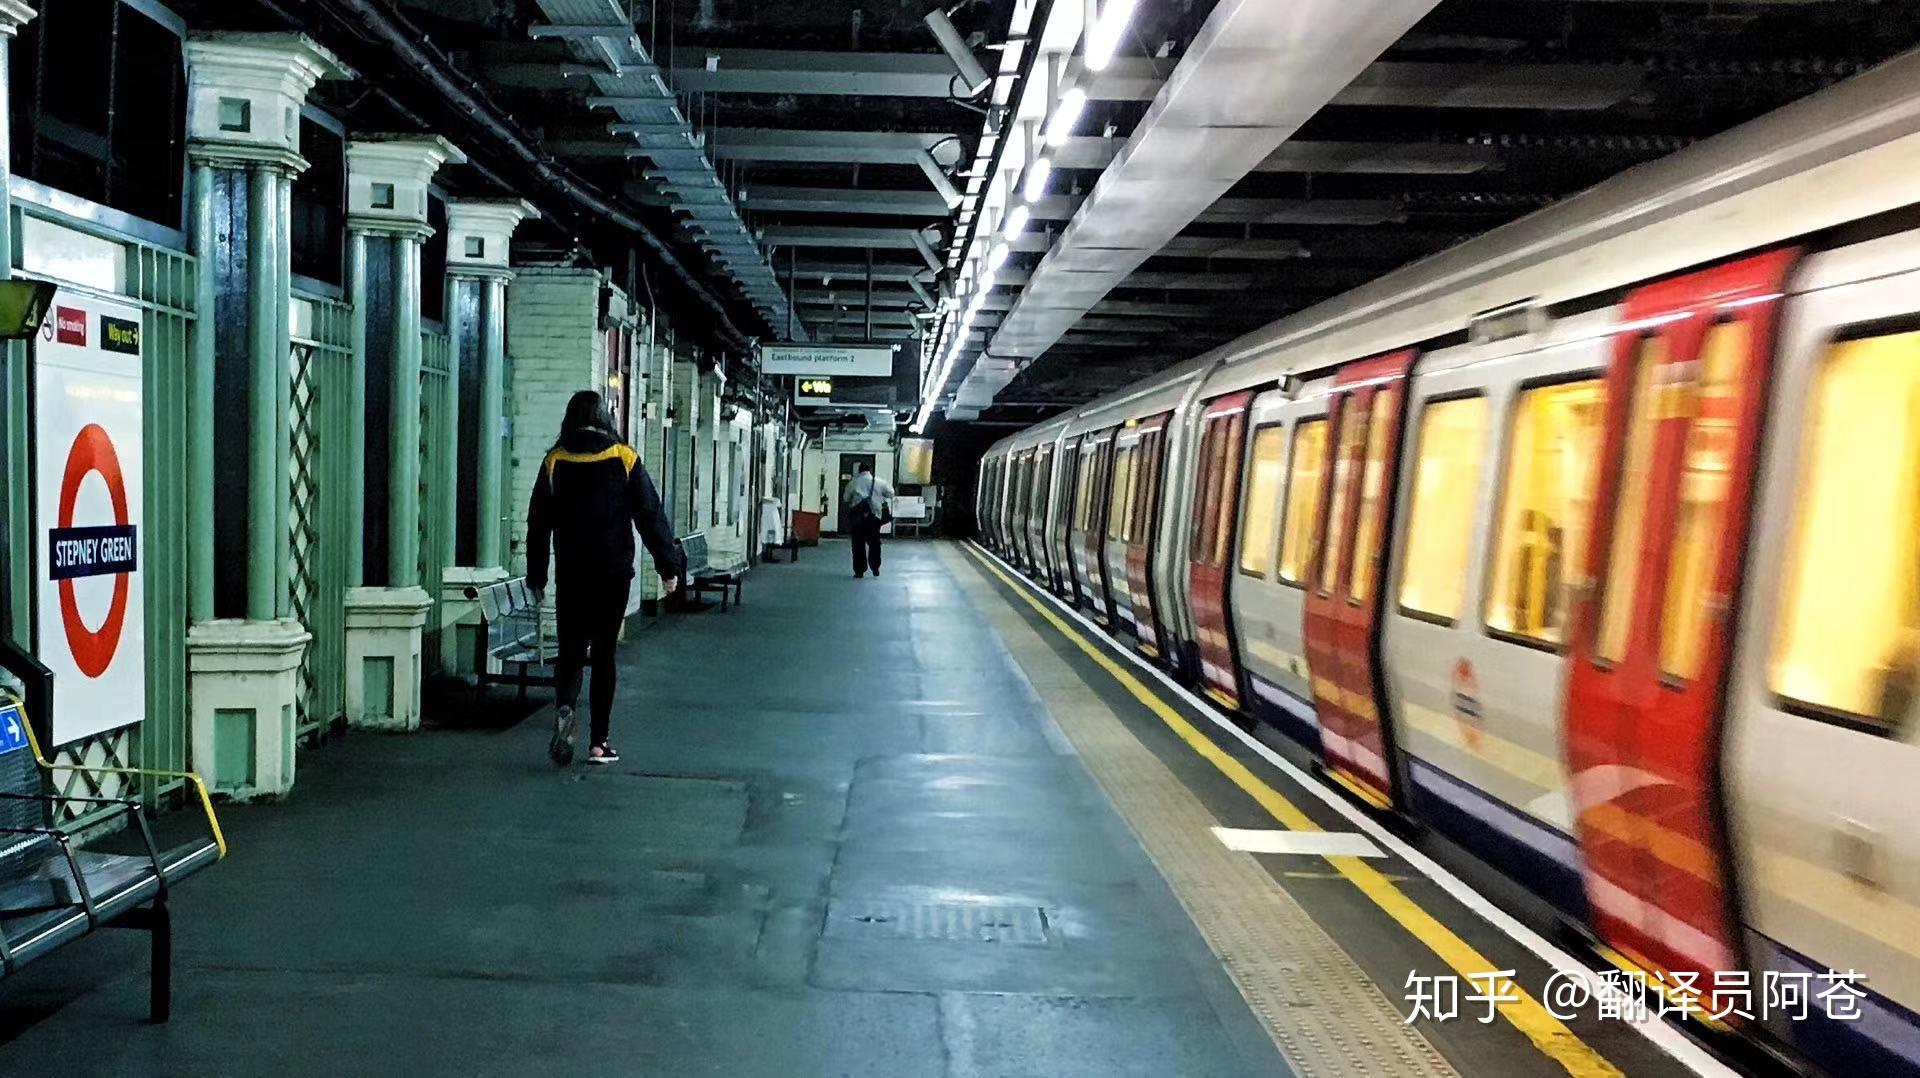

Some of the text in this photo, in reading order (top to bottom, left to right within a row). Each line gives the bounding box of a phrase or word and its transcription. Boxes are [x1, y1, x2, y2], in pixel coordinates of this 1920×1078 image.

[58, 317, 66, 330] No
[108, 323, 133, 346] Way out
[771, 353, 855, 363] Eastbound platform 2
[812, 380, 832, 394] Wa
[56, 536, 132, 568] STEPNEY GREEN
